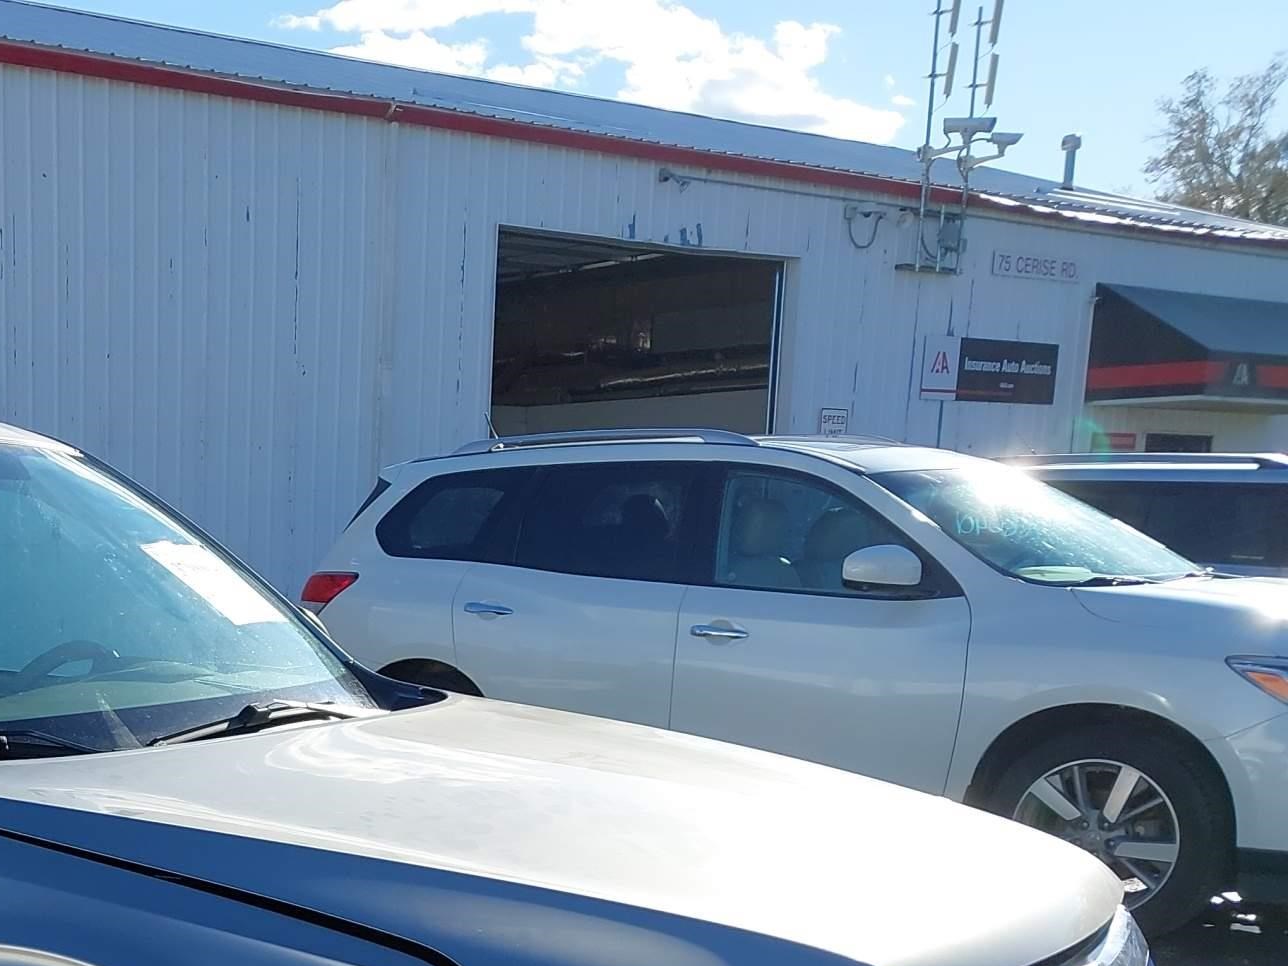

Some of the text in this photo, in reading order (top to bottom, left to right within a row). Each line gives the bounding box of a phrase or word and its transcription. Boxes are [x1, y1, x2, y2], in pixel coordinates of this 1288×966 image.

[998, 254, 1012, 272] 75
[1015, 256, 1057, 277] CERISE
[964, 356, 1051, 376] Insurance Auto Auctions
[823, 415, 846, 424] SPEED
